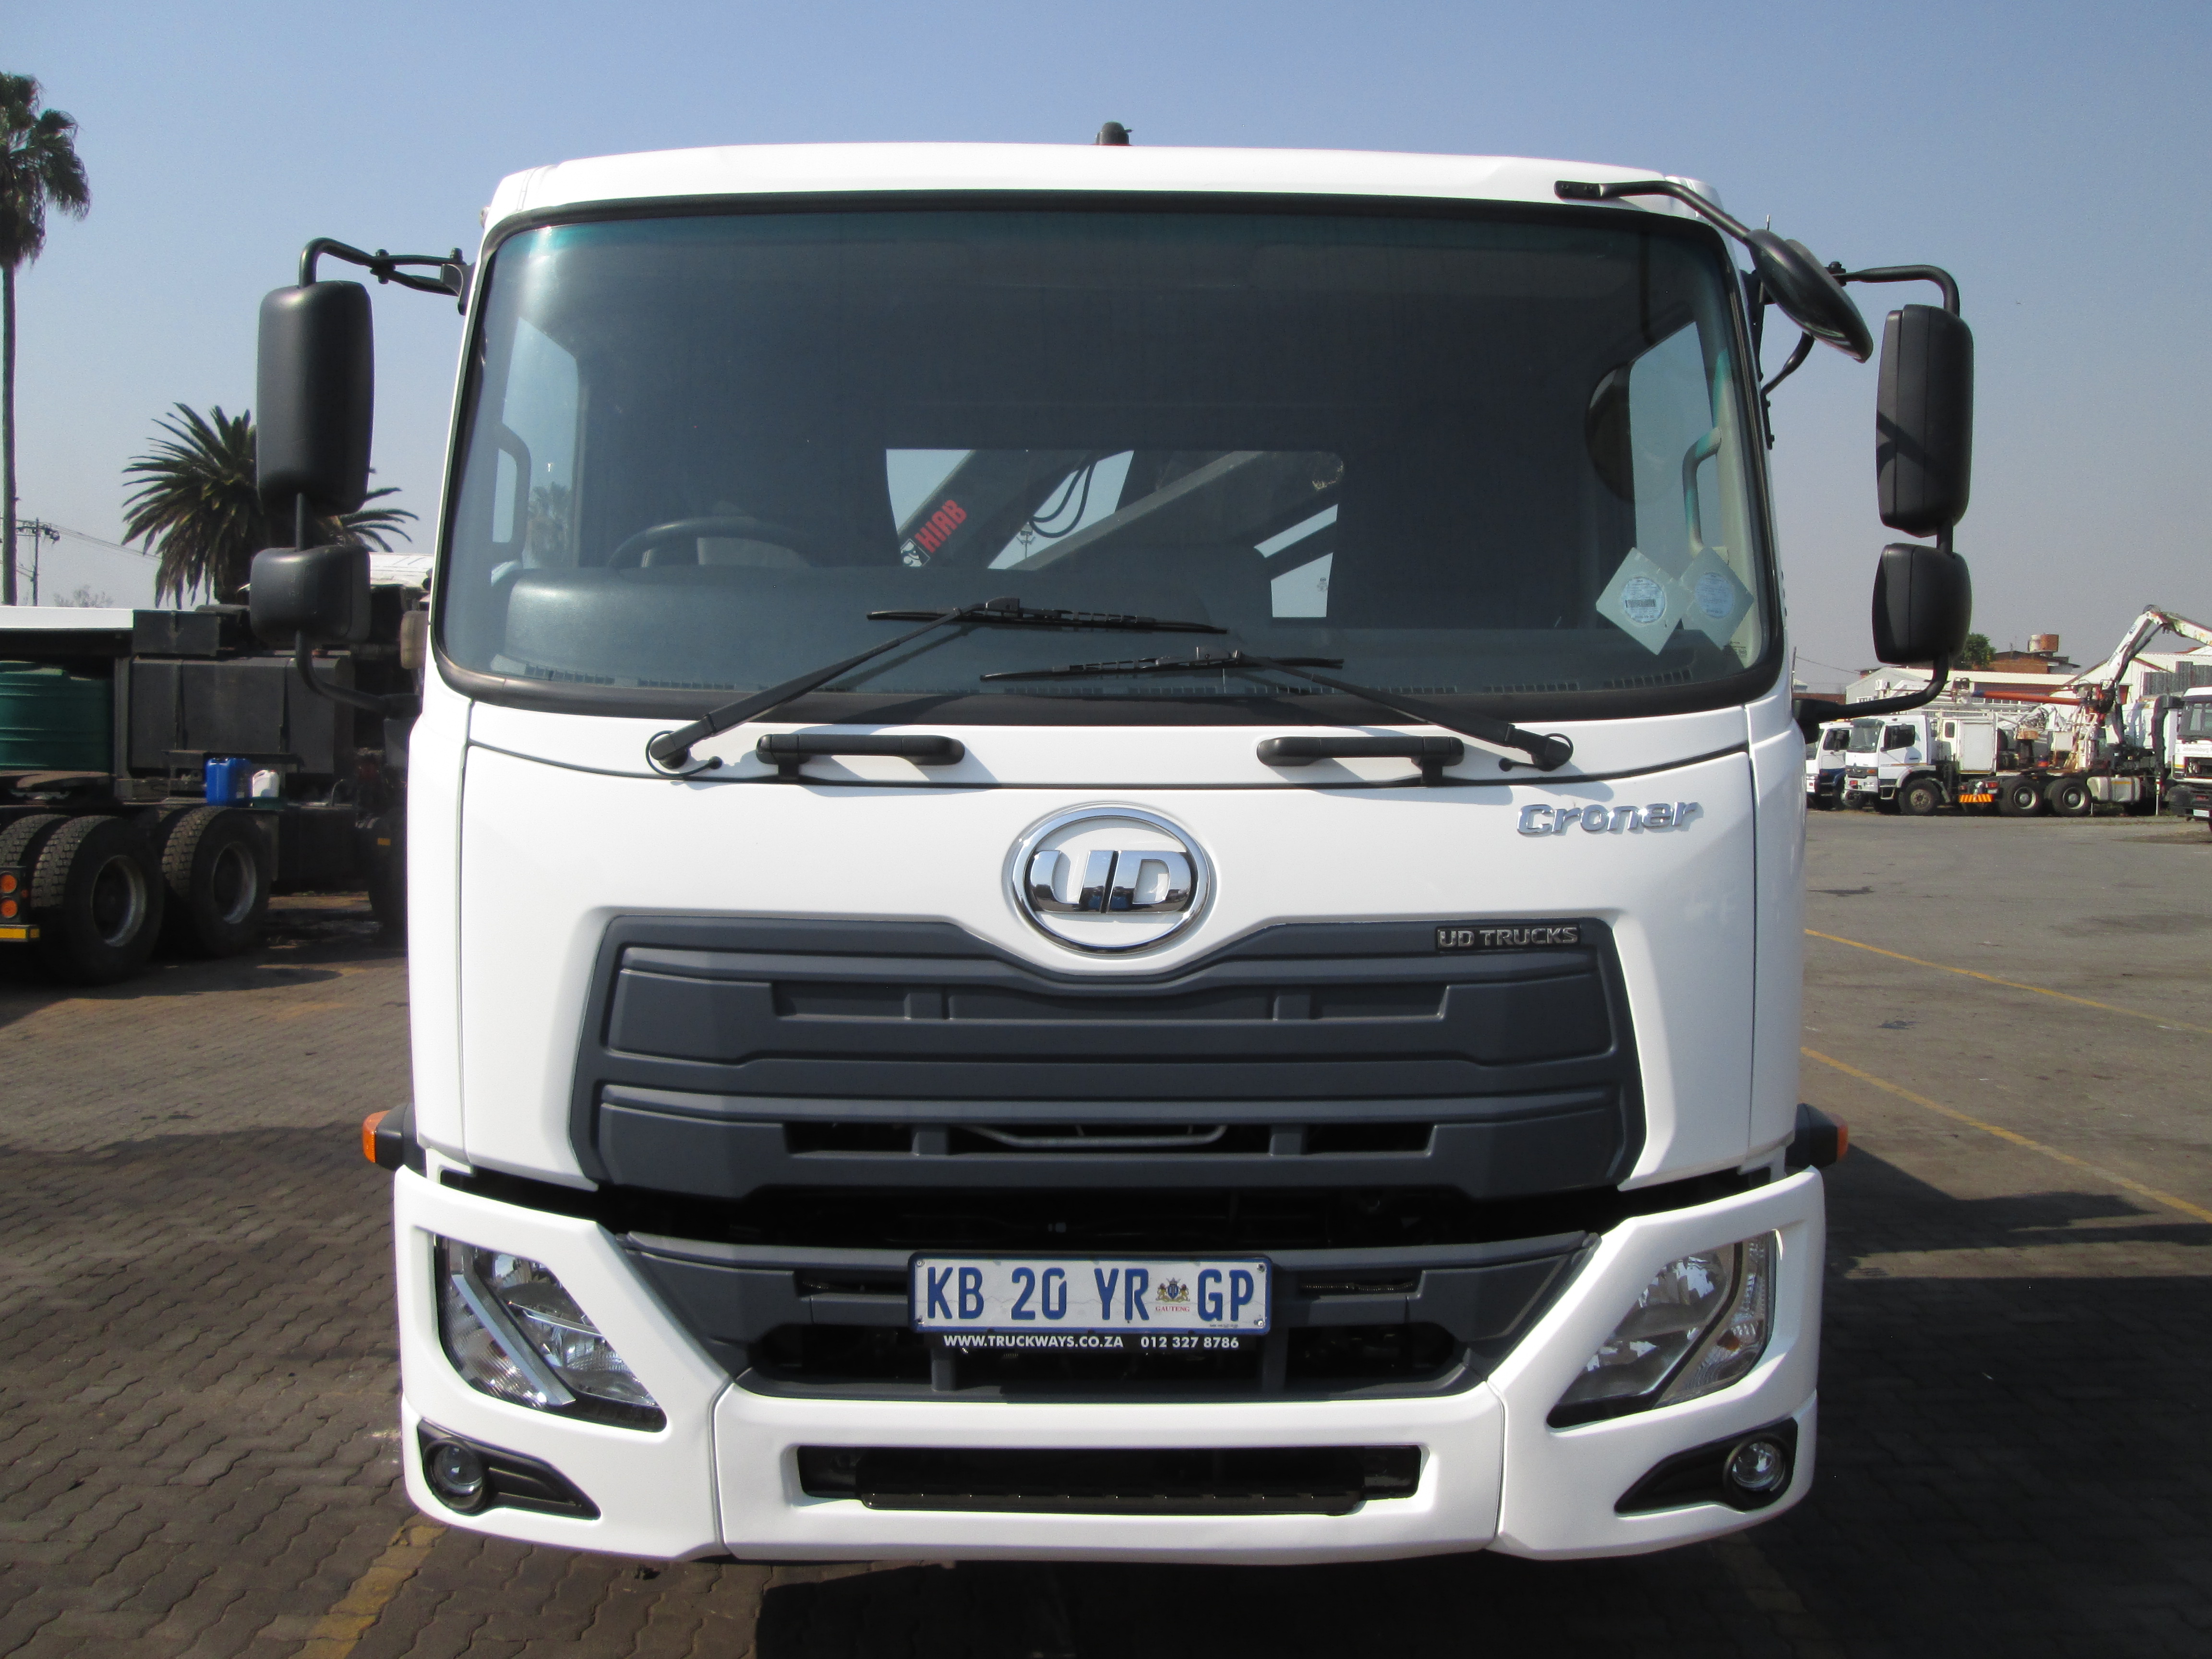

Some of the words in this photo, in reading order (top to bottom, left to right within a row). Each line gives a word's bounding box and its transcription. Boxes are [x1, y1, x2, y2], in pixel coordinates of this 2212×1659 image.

[914, 500, 967, 553] HIAB
[1517, 801, 1699, 834] Croner
[1030, 850, 1192, 913] UD
[1440, 930, 1475, 947] UD
[1479, 927, 1578, 946] TRUCKS
[927, 1266, 984, 1320] KB
[1011, 1266, 1067, 1320] 20
[1094, 1268, 1149, 1321] YR
[1198, 1268, 1254, 1322] GP
[943, 1335, 1124, 1348] WWW.TRUCKWAYS.CO.ZA
[1141, 1336, 1167, 1347] 012
[1172, 1336, 1199, 1348] 327
[1203, 1337, 1239, 1348] 8786
